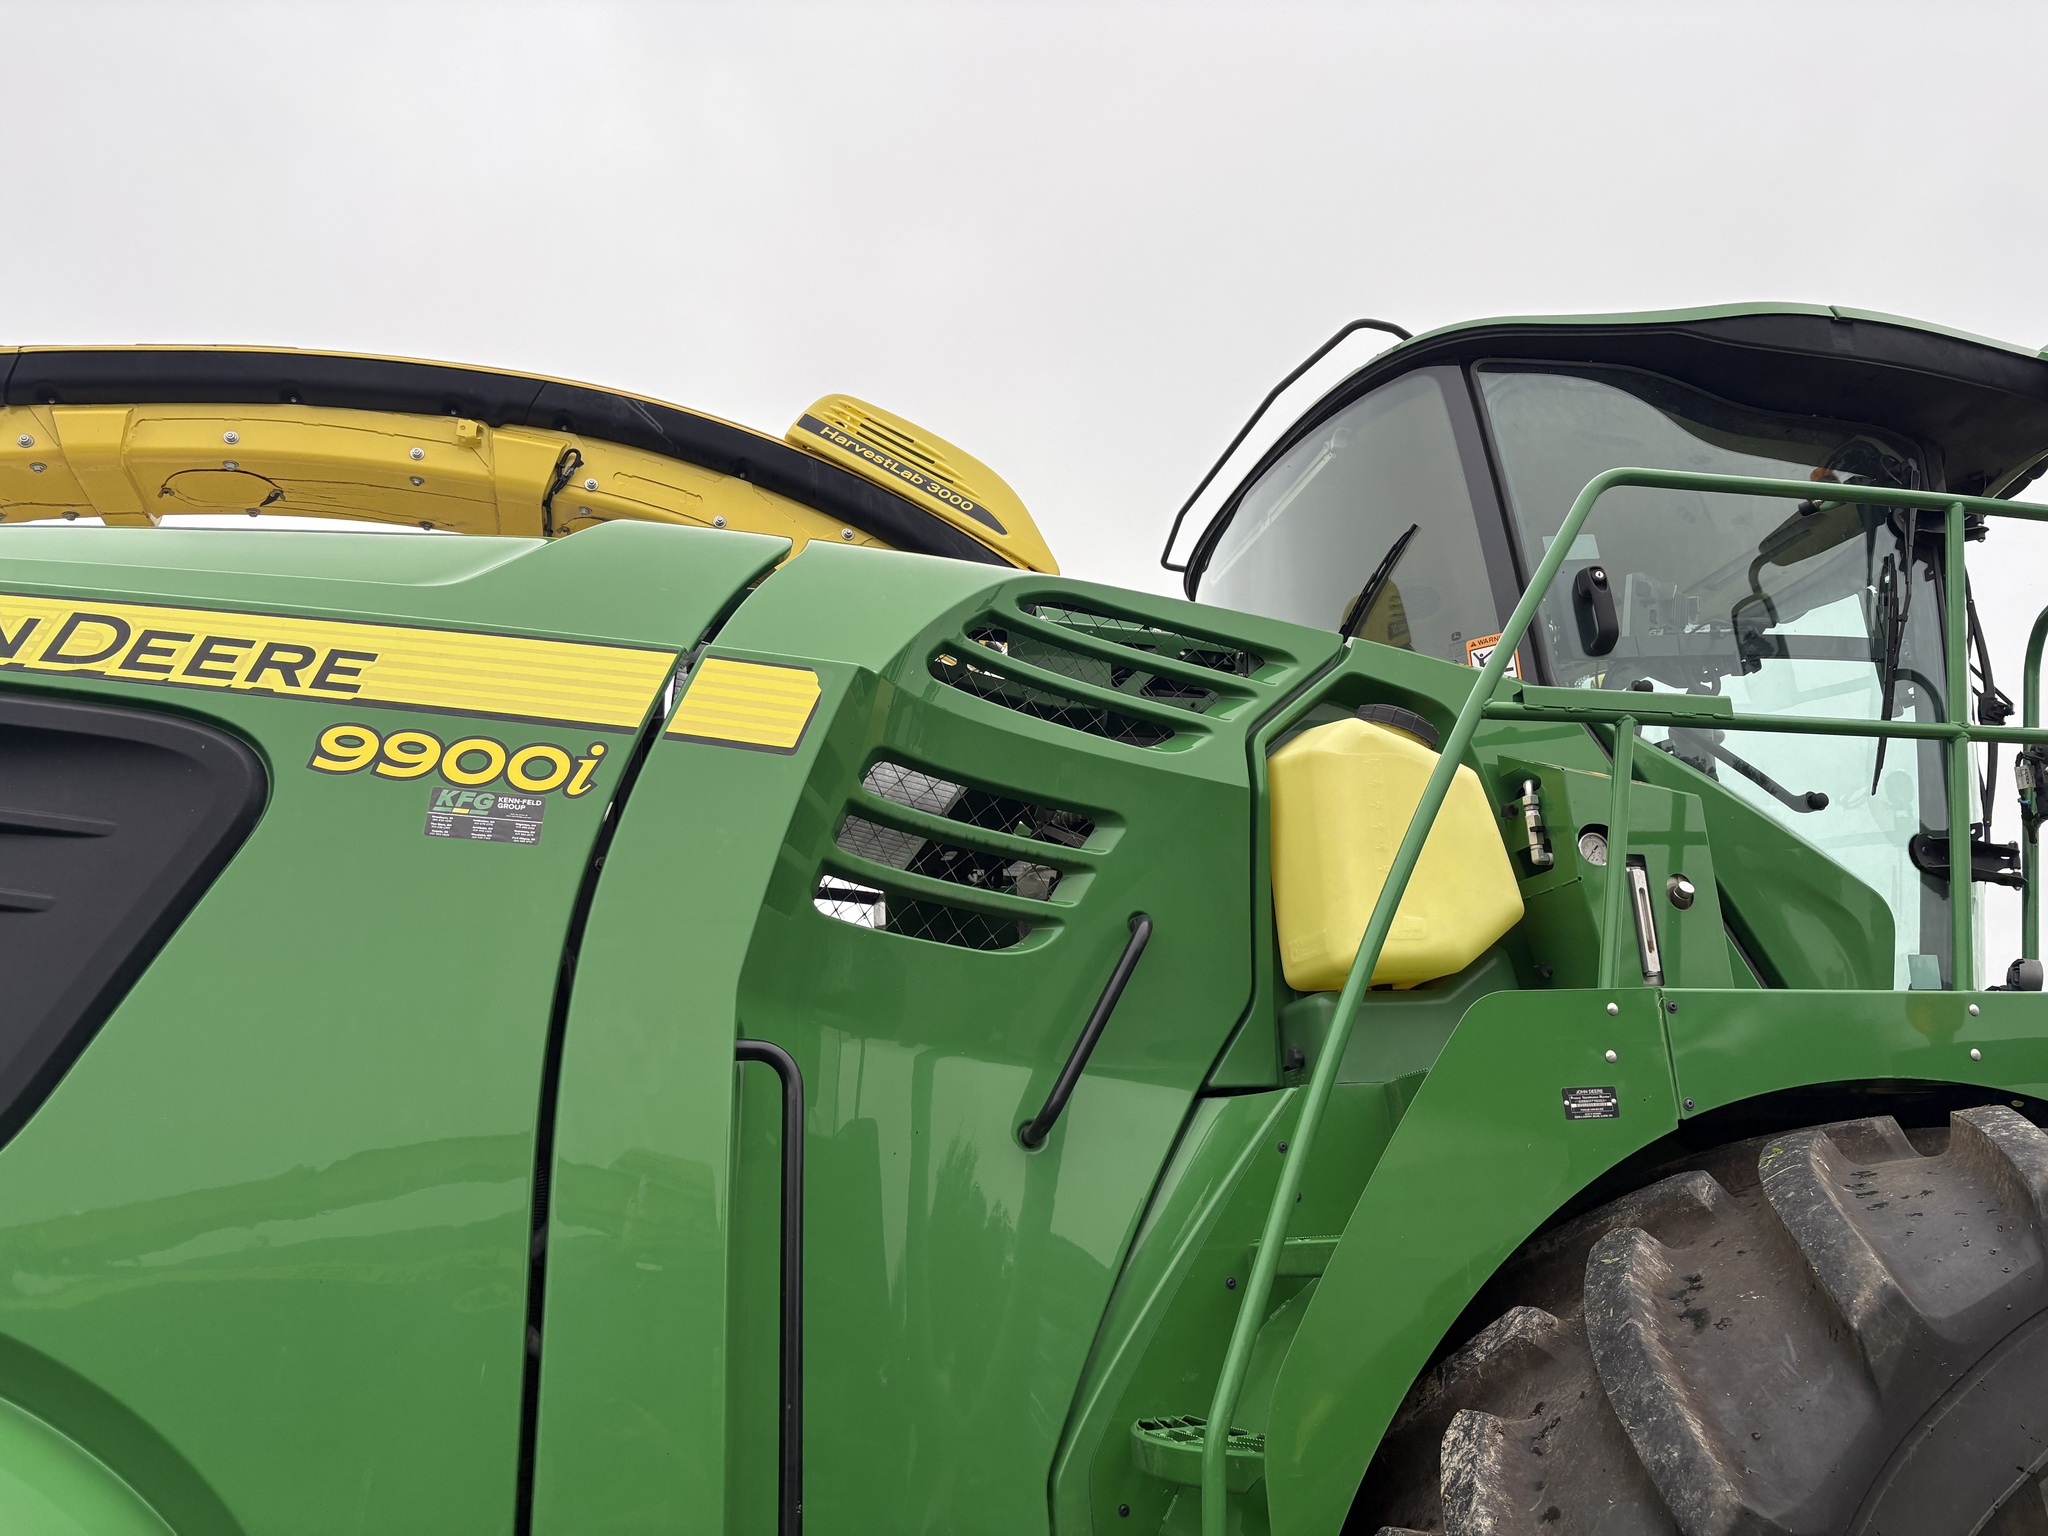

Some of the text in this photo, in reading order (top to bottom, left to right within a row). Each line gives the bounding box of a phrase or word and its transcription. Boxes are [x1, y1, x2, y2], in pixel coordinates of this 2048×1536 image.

[820, 427, 974, 511] HarvestLab 3000
[1477, 635, 1502, 645] WARN
[38, 612, 379, 694] DEERE
[306, 722, 608, 798] 9900i
[435, 789, 496, 810] KFG
[497, 802, 526, 811] GROUP
[498, 796, 542, 806] KENN-FELD
